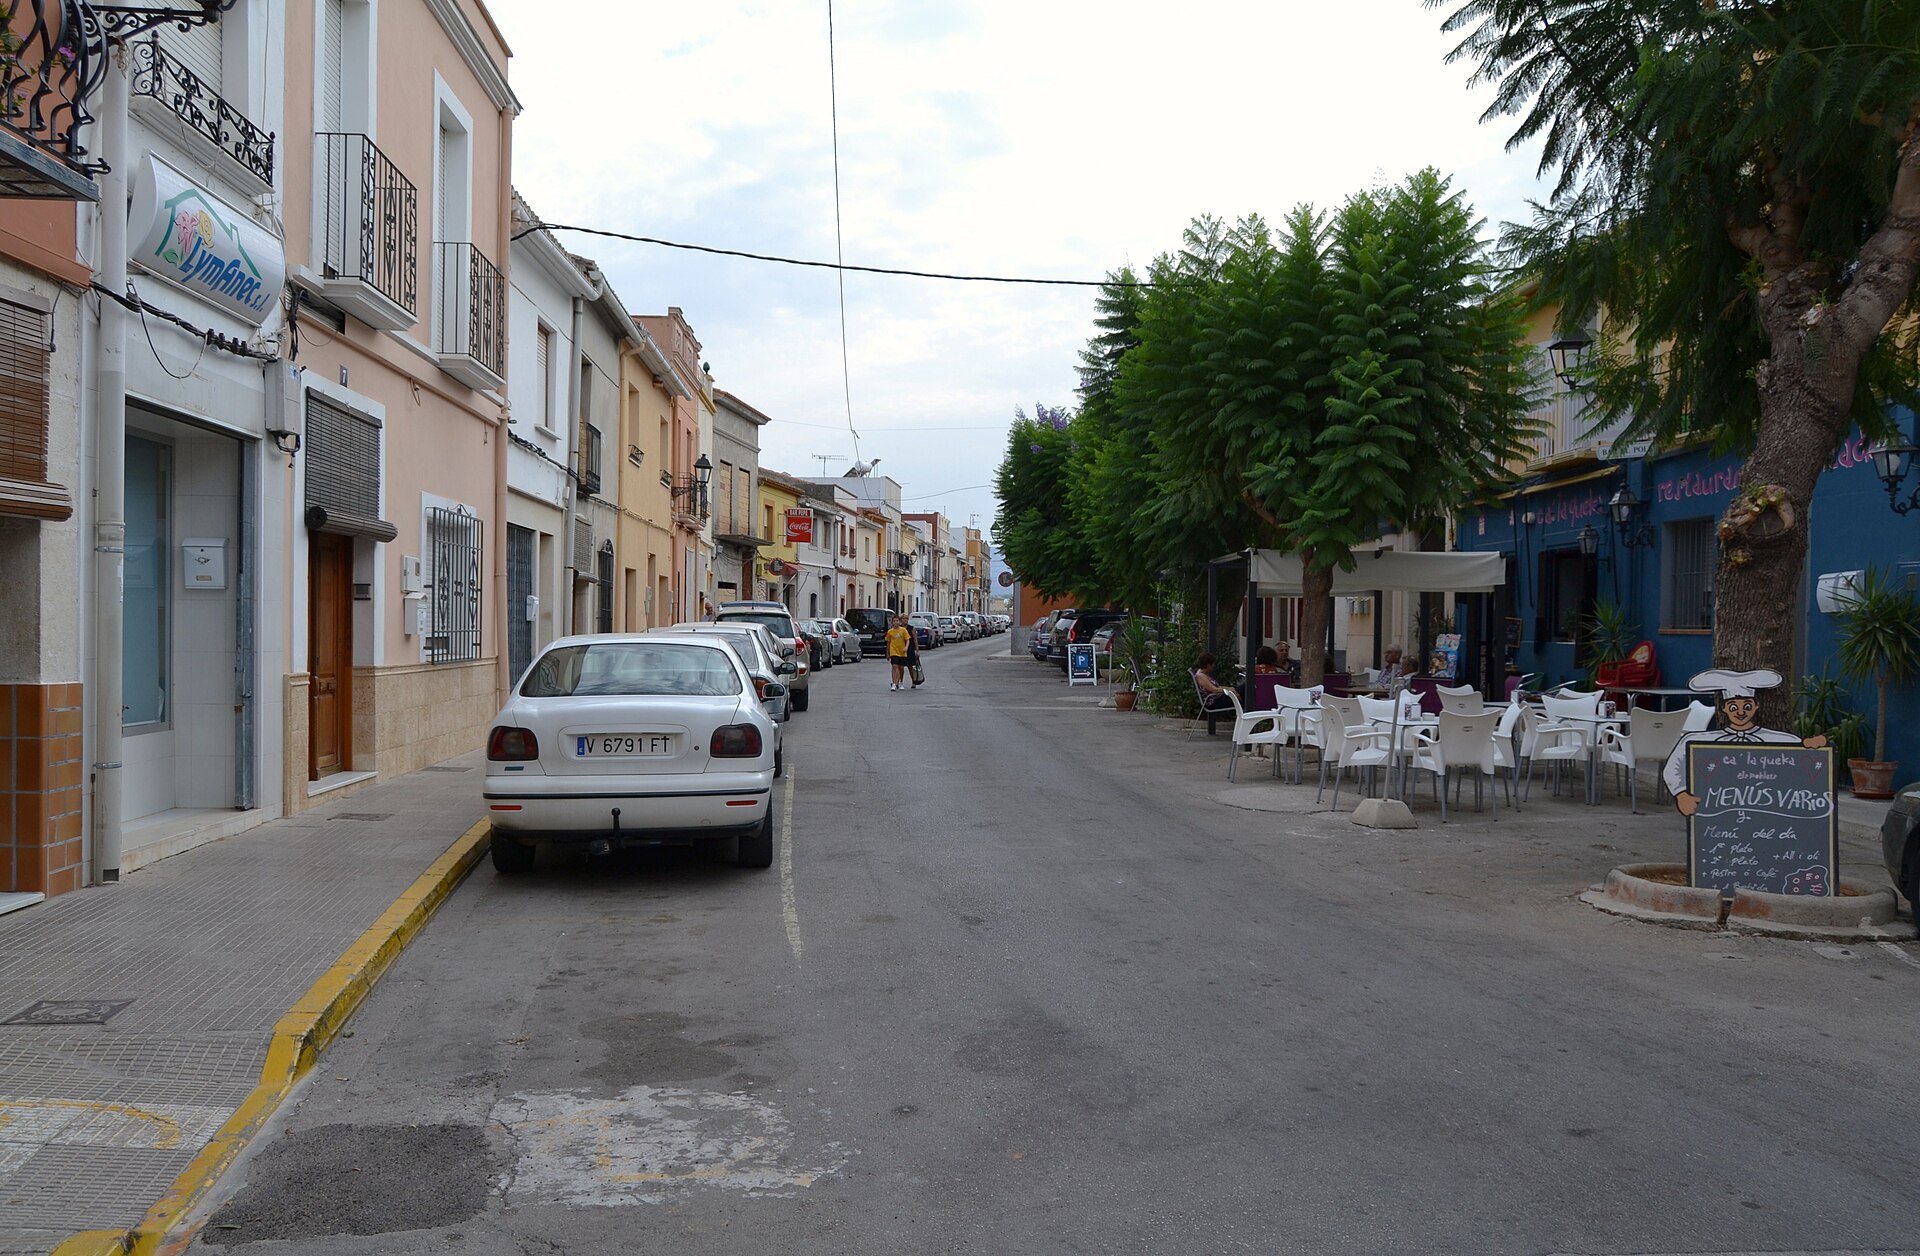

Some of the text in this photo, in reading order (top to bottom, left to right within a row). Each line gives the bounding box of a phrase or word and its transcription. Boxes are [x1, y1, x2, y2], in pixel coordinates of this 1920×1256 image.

[1078, 655, 1086, 666] P
[584, 735, 670, 754] V 6791 FT
[1760, 752, 1797, 769] queka
[1705, 782, 1773, 809] MENÚS
[1703, 825, 1740, 839] Menú
[1752, 828, 1776, 840] del
